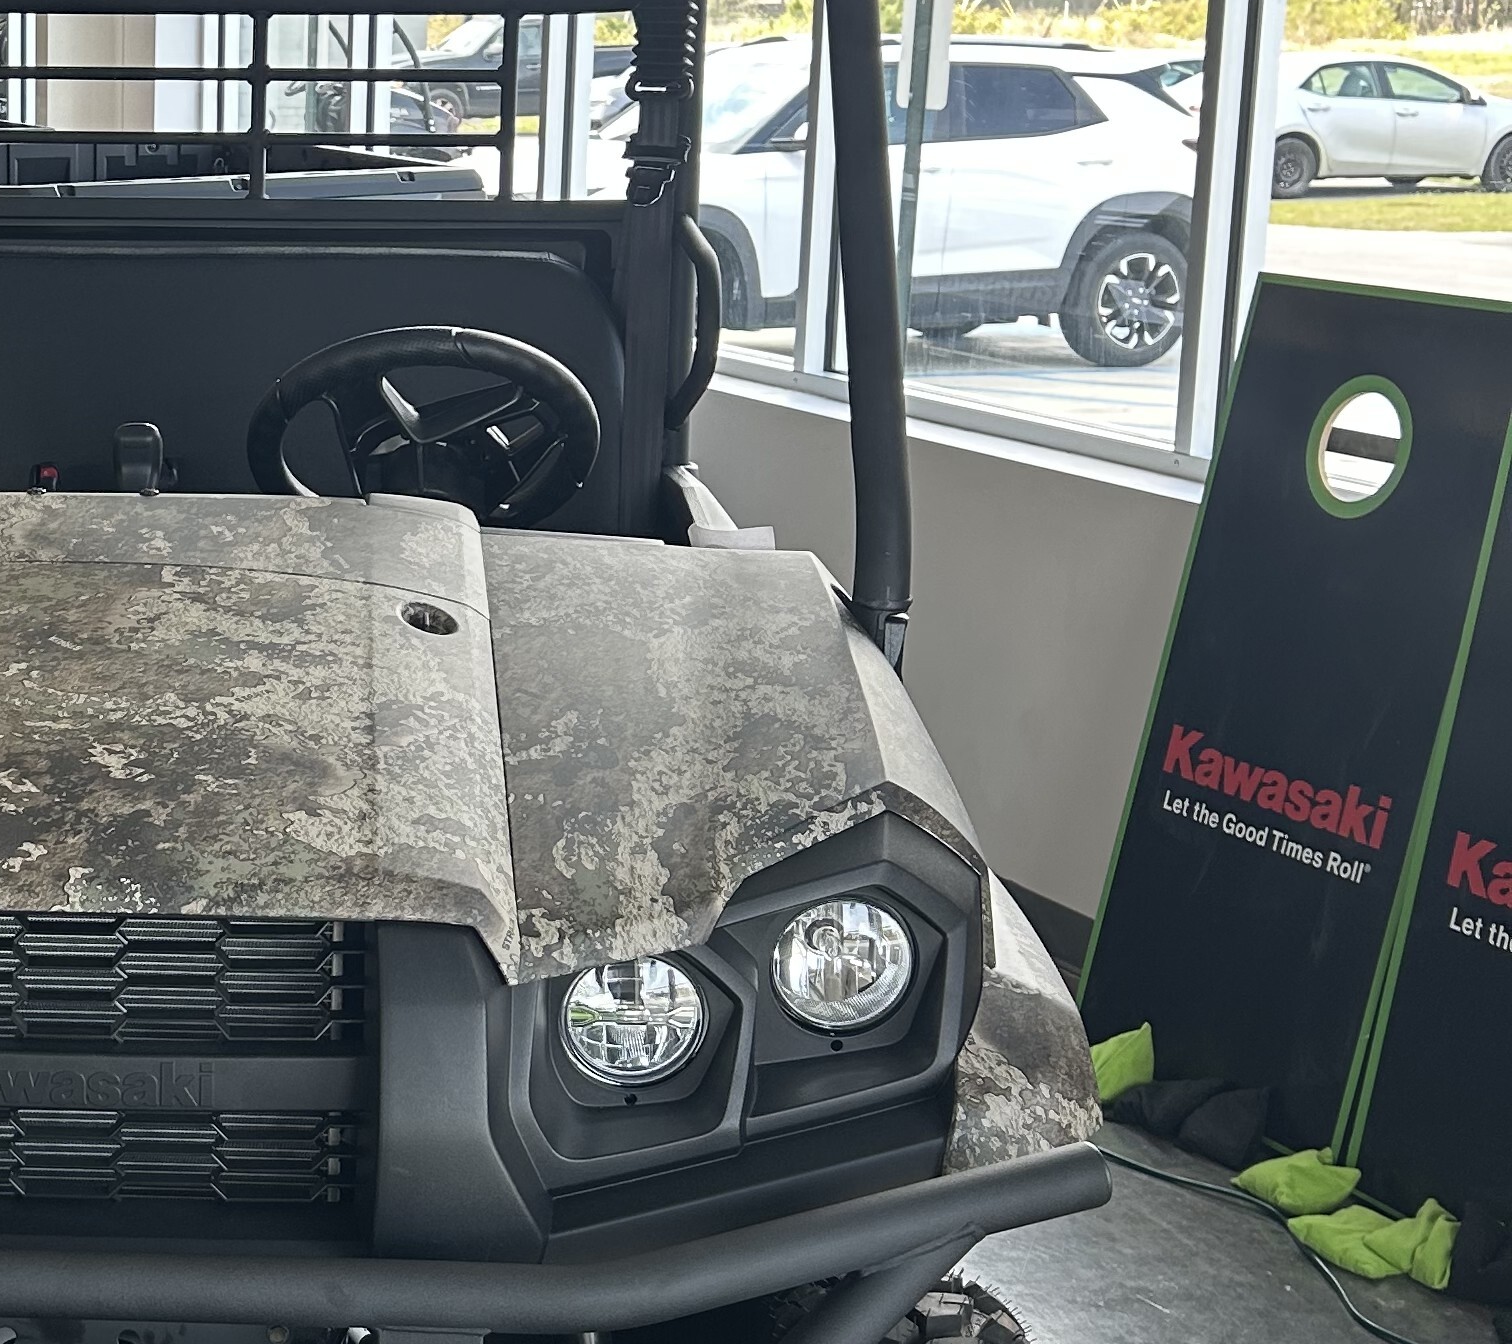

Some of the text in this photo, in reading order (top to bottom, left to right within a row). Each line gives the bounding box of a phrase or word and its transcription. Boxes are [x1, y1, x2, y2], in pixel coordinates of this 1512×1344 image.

[1162, 724, 1392, 849] Kawasaki
[1163, 789, 1190, 818] Let
[1192, 802, 1219, 829] the
[1222, 814, 1269, 847] Good
[1271, 829, 1324, 869] Times
[1450, 907, 1512, 952] Let th
